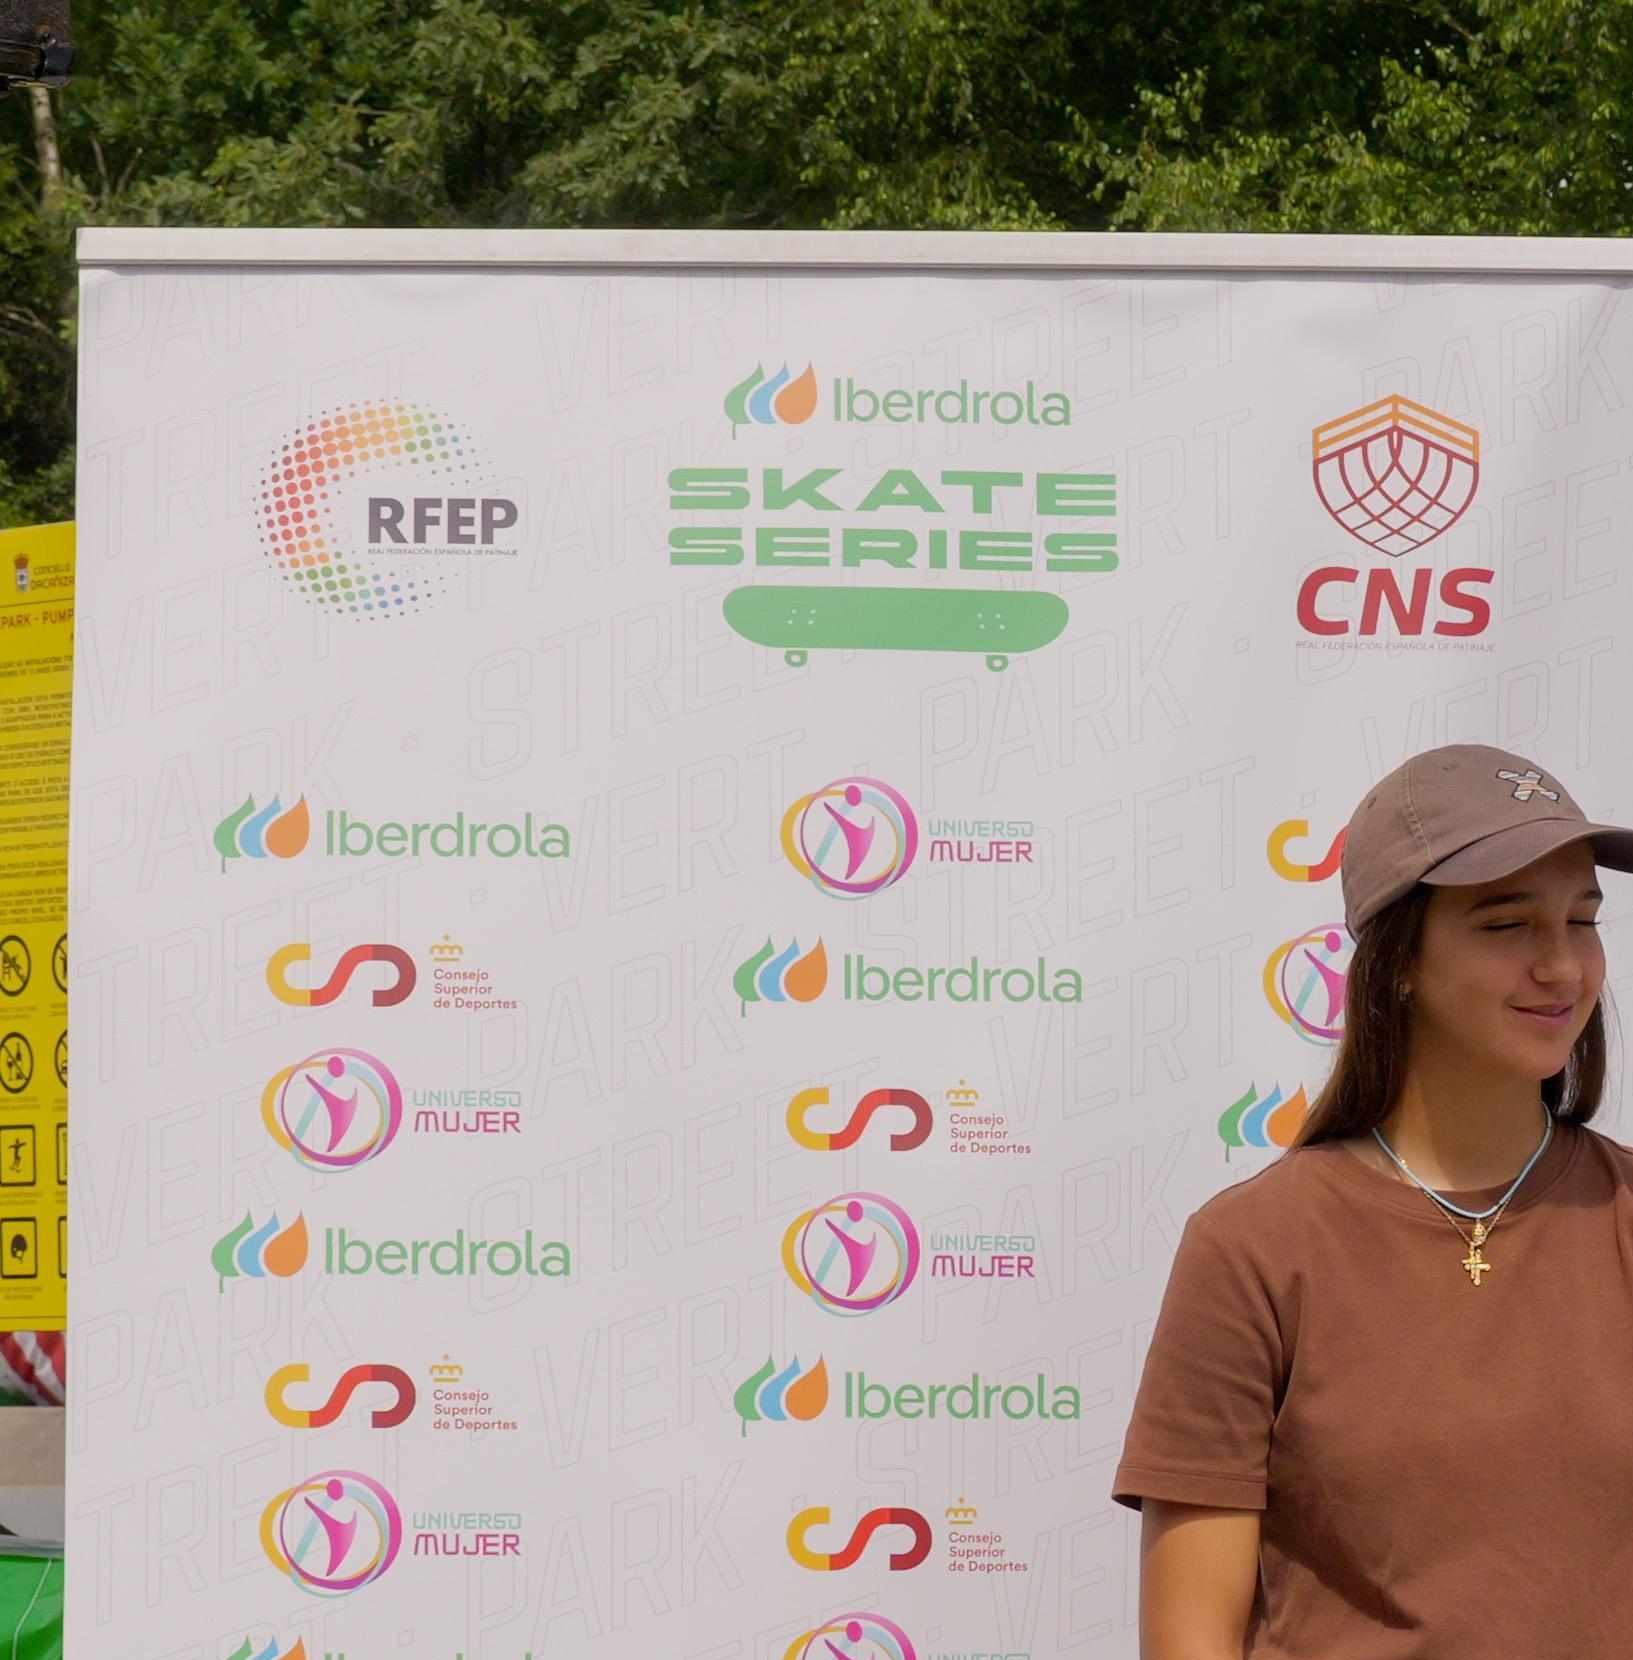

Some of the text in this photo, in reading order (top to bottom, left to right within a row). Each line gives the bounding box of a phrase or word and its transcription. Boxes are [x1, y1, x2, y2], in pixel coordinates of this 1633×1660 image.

[834, 378, 1070, 426] Iberdrola
[668, 468, 1116, 516] SKATE
[369, 498, 518, 544] RFEP
[669, 527, 1119, 572] SERIES
[1297, 567, 1494, 636] CNS
[1296, 640, 1319, 651] REAL
[1322, 640, 1383, 651] FEDERACIÓN
[1385, 640, 1435, 652] ESPAÑOLA
[1452, 642, 1496, 653] PATINAJE
[327, 810, 569, 858] Iberdrola
[929, 820, 1034, 837] UNIVERSO
[929, 838, 1034, 863] MUJER
[434, 969, 488, 981] Consejo
[844, 954, 1082, 1003] Iberdrola
[434, 982, 493, 997] Superior
[434, 997, 517, 1011] de Deportes
[413, 1090, 521, 1107] UNIVERSO
[414, 1111, 521, 1133] MUJER
[950, 1113, 1004, 1126] Consejo
[951, 1127, 1008, 1141] Superior
[950, 1142, 1031, 1156] de Deportes
[325, 1228, 570, 1276] Iberdrola
[931, 1235, 1035, 1252] UNIVERSO
[931, 1255, 1035, 1278] MUJER
[433, 1389, 489, 1402] Consejo
[846, 1372, 1080, 1420] Iberdrola
[434, 1402, 492, 1417] Superior
[434, 1418, 517, 1432] de Deportes
[413, 1513, 521, 1529] UNIVERSO
[414, 1533, 521, 1556] MUJER
[949, 1532, 1002, 1545] Consejo
[950, 1546, 1005, 1559] Superior
[948, 1561, 1028, 1574] de Deportes
